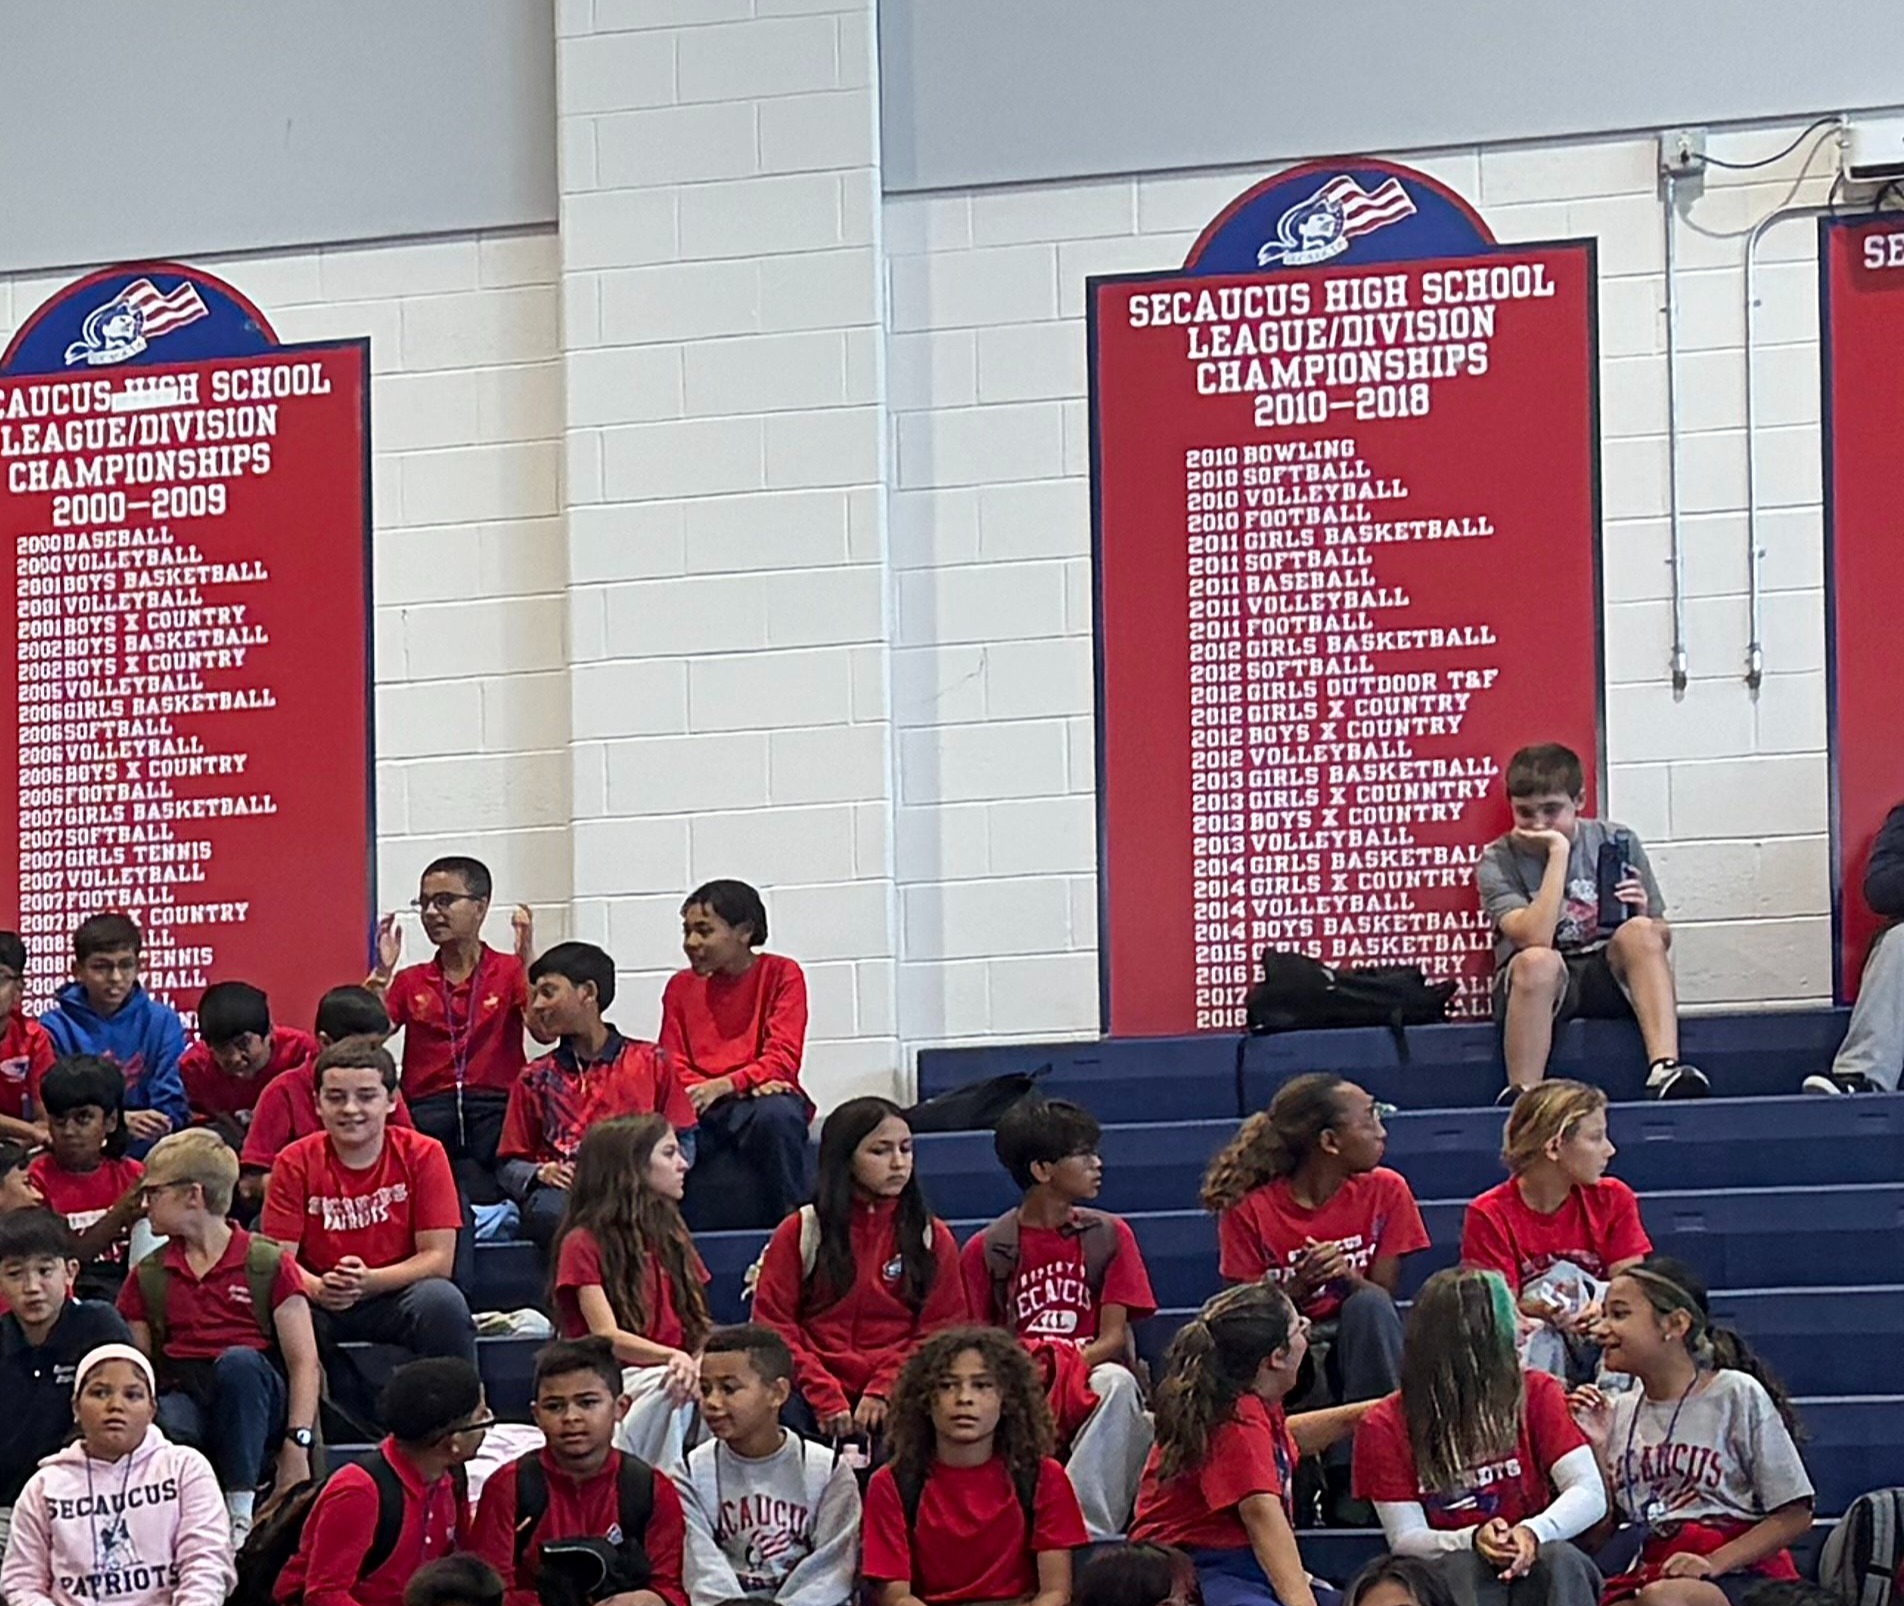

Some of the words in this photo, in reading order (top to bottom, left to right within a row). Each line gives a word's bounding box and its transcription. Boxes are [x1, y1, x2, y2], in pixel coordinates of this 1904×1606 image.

[1129, 282, 1311, 328] SECAUCUS
[1324, 274, 1409, 313] HIGH
[1422, 264, 1555, 307] SCHOOL
[1187, 304, 1496, 360] LEAGUE/DIVISION
[211, 363, 332, 402] SCHOOL
[1196, 342, 1488, 395] CHAMPIONSHIPS
[0, 404, 278, 457] LEAGUE/DIVISION
[8, 442, 271, 493] CHAMPIONSHIPS
[1186, 446, 1238, 469] 2010
[1243, 439, 1355, 465] BOWLING
[1186, 468, 1239, 491] 2010
[1242, 460, 1371, 487] SOFTBALL
[1187, 490, 1239, 512] 2010
[1244, 479, 1408, 508] VOLLEYBALL
[1187, 511, 1240, 533] 2010
[1244, 503, 1372, 530] FOOTBALL
[1187, 533, 1239, 555] 2011
[1244, 528, 1315, 551] GIRLS
[1324, 516, 1495, 546] BASKETBALL
[63, 545, 203, 573] VOLLEYBALL
[1188, 554, 1240, 577] 2011
[1244, 546, 1373, 573] SOFTBALL
[63, 572, 116, 594] BOYS
[123, 561, 268, 590] BASKETBALL
[1188, 576, 1240, 598] 2011
[1246, 567, 1376, 595] BASEBALL
[1189, 598, 1241, 620] 2011
[1246, 587, 1410, 616] VOLLEYBALL
[1189, 619, 1241, 641] 2011
[1246, 611, 1374, 638] FOOTBALL
[1189, 640, 1242, 663] 2012
[1246, 636, 1317, 659] GIRLS
[1326, 625, 1497, 655] BASKETBALL
[64, 656, 117, 679] BOYS
[124, 655, 140, 674] X
[147, 647, 246, 673] COUNTRY
[1190, 662, 1243, 684] 2012
[1246, 654, 1375, 681] SOFTBALL
[1190, 684, 1243, 706] 2012
[1246, 679, 1318, 702] GIRLS
[1326, 672, 1437, 698] OUTDOOR
[1446, 668, 1499, 690] T&F
[1191, 705, 1243, 727] 2012
[1247, 701, 1318, 724] GIRLS
[1327, 699, 1345, 719] X
[1354, 692, 1471, 717] COUNTRY
[1191, 727, 1243, 749] 2012
[1248, 723, 1310, 746] BOYS
[1319, 721, 1337, 742] X
[1346, 714, 1463, 740] COUNTRY
[1191, 748, 1244, 770] 2012
[1248, 739, 1413, 767] VOLLEYBALL
[1192, 792, 1245, 813] 2013
[1248, 787, 1320, 811] GIRLS
[1329, 786, 1347, 806] X
[65, 846, 126, 868] GIRLS
[132, 841, 212, 864] TENNIS
[65, 885, 175, 911] FOOTBALL
[44, 1477, 179, 1520] SECAUCUS
